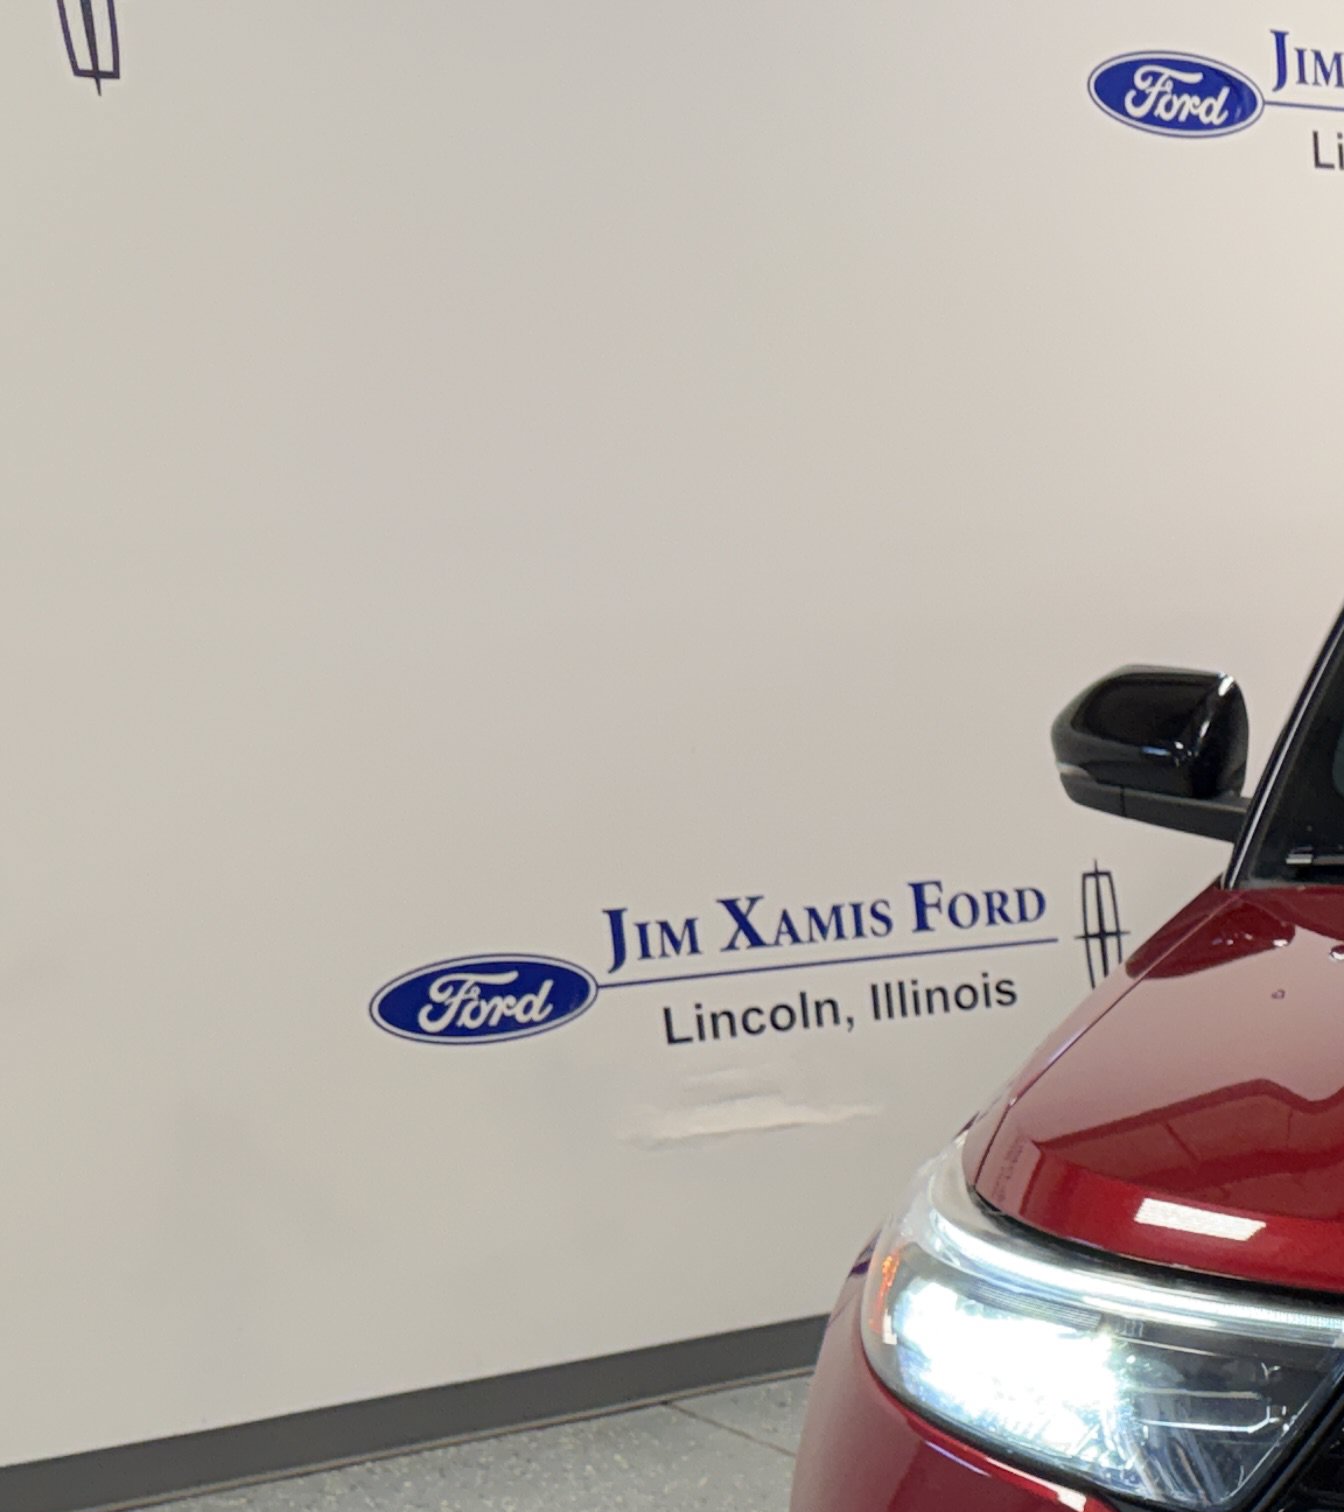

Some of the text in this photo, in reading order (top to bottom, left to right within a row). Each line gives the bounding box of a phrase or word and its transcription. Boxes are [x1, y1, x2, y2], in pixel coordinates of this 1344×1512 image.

[1124, 64, 1229, 126] Ford
[602, 880, 1046, 975] JIM XAMIS FORD
[418, 970, 554, 1034] Ford
[663, 973, 1017, 1047] Lincoln, Illinois
